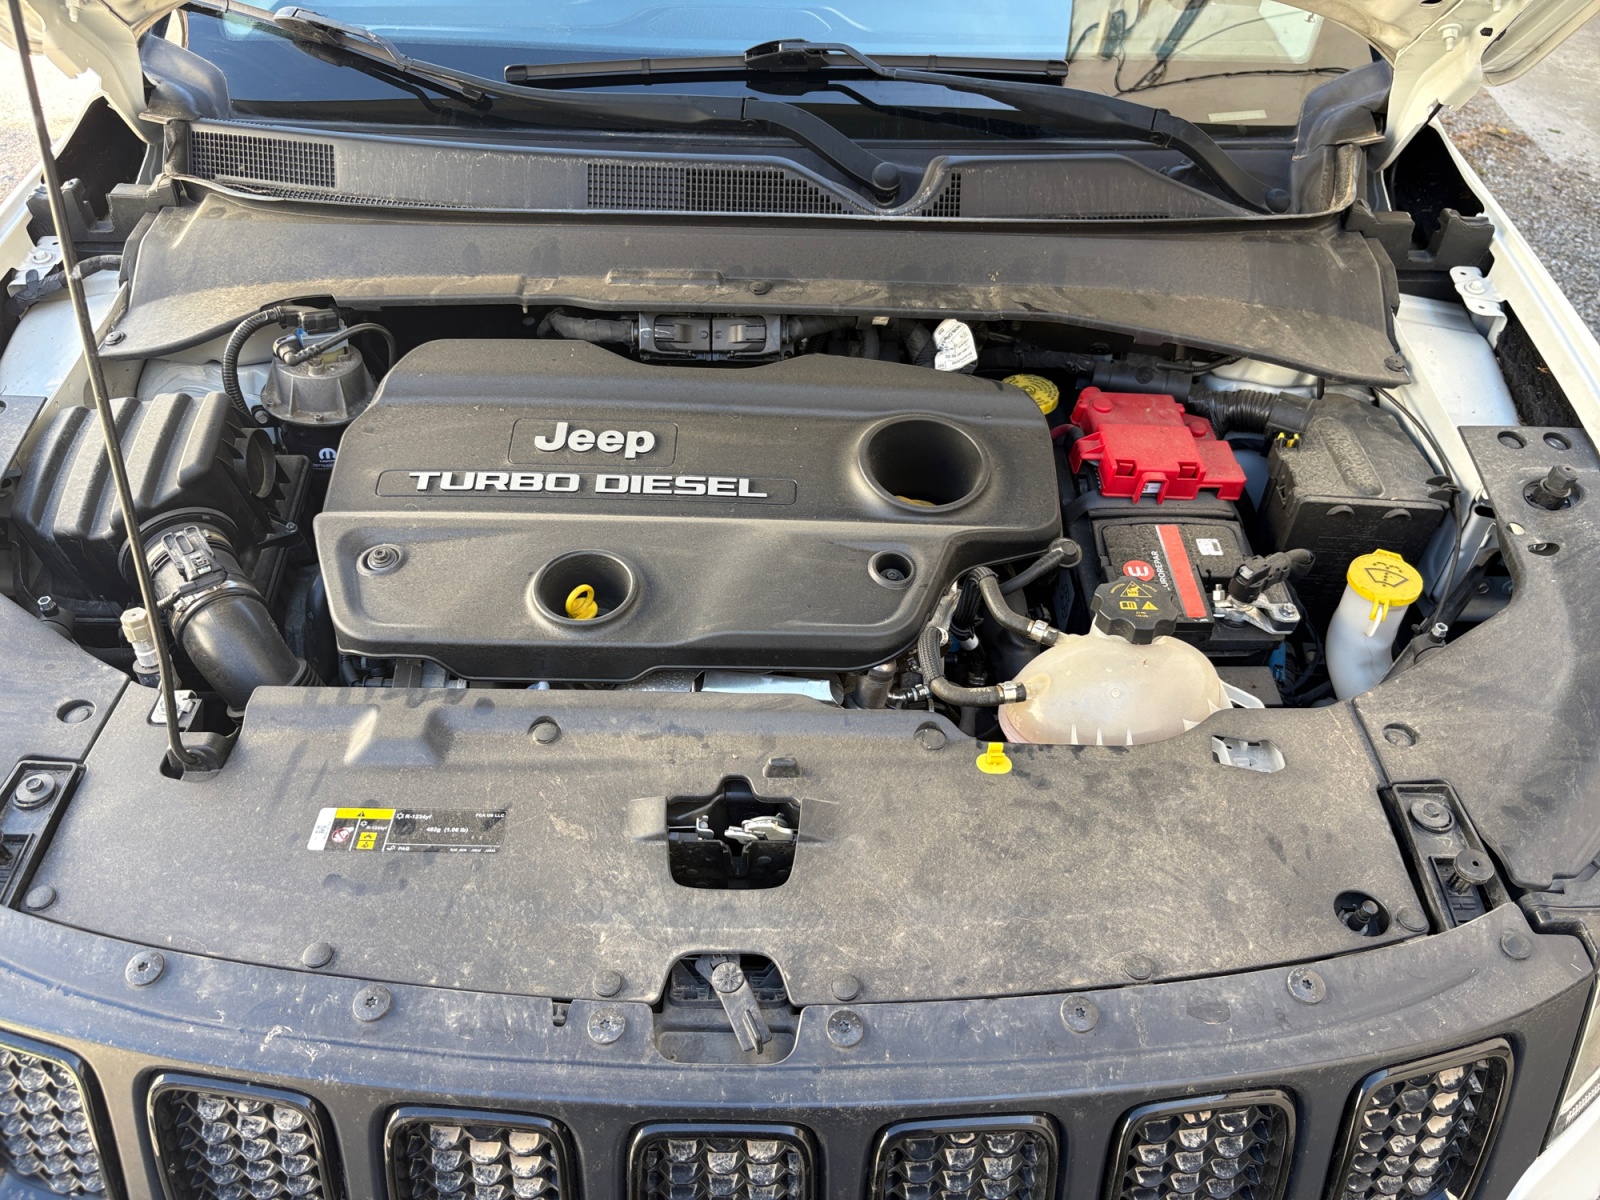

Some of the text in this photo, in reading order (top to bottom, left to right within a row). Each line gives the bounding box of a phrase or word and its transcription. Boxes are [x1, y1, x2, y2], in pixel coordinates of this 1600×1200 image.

[534, 422, 656, 459] Jeep
[409, 472, 768, 498] TURBO DIESEL
[1151, 550, 1171, 592] UROREPAR
